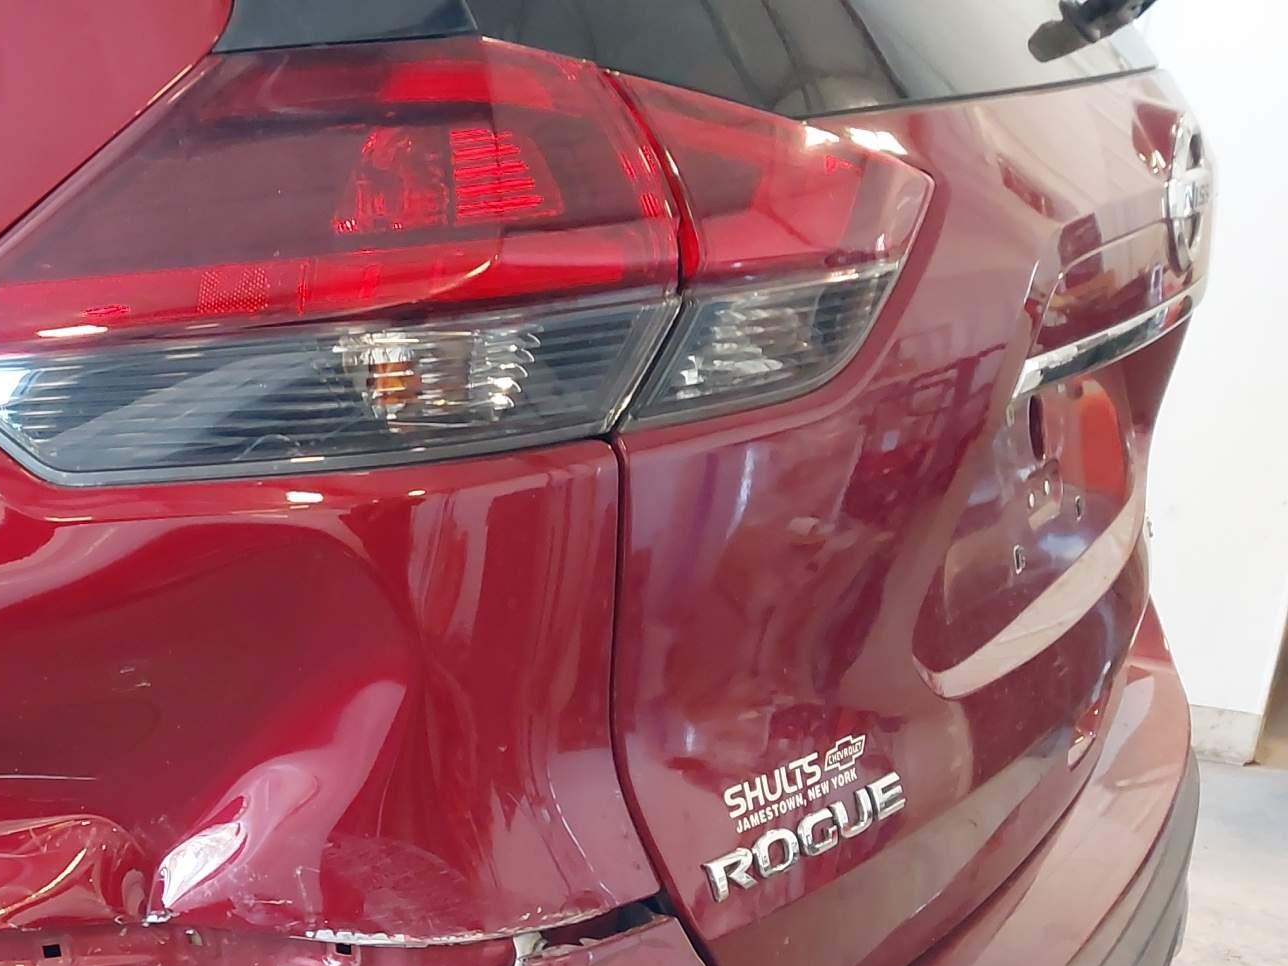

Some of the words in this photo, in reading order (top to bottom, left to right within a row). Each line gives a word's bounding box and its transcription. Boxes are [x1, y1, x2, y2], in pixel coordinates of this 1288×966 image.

[724, 752, 822, 818] SHULTS
[828, 741, 863, 766] CHEVROLET
[736, 794, 808, 833] JAMESTOWN,
[808, 781, 830, 801] NEW
[831, 768, 858, 790] YORK
[701, 772, 907, 903] ROGUE
